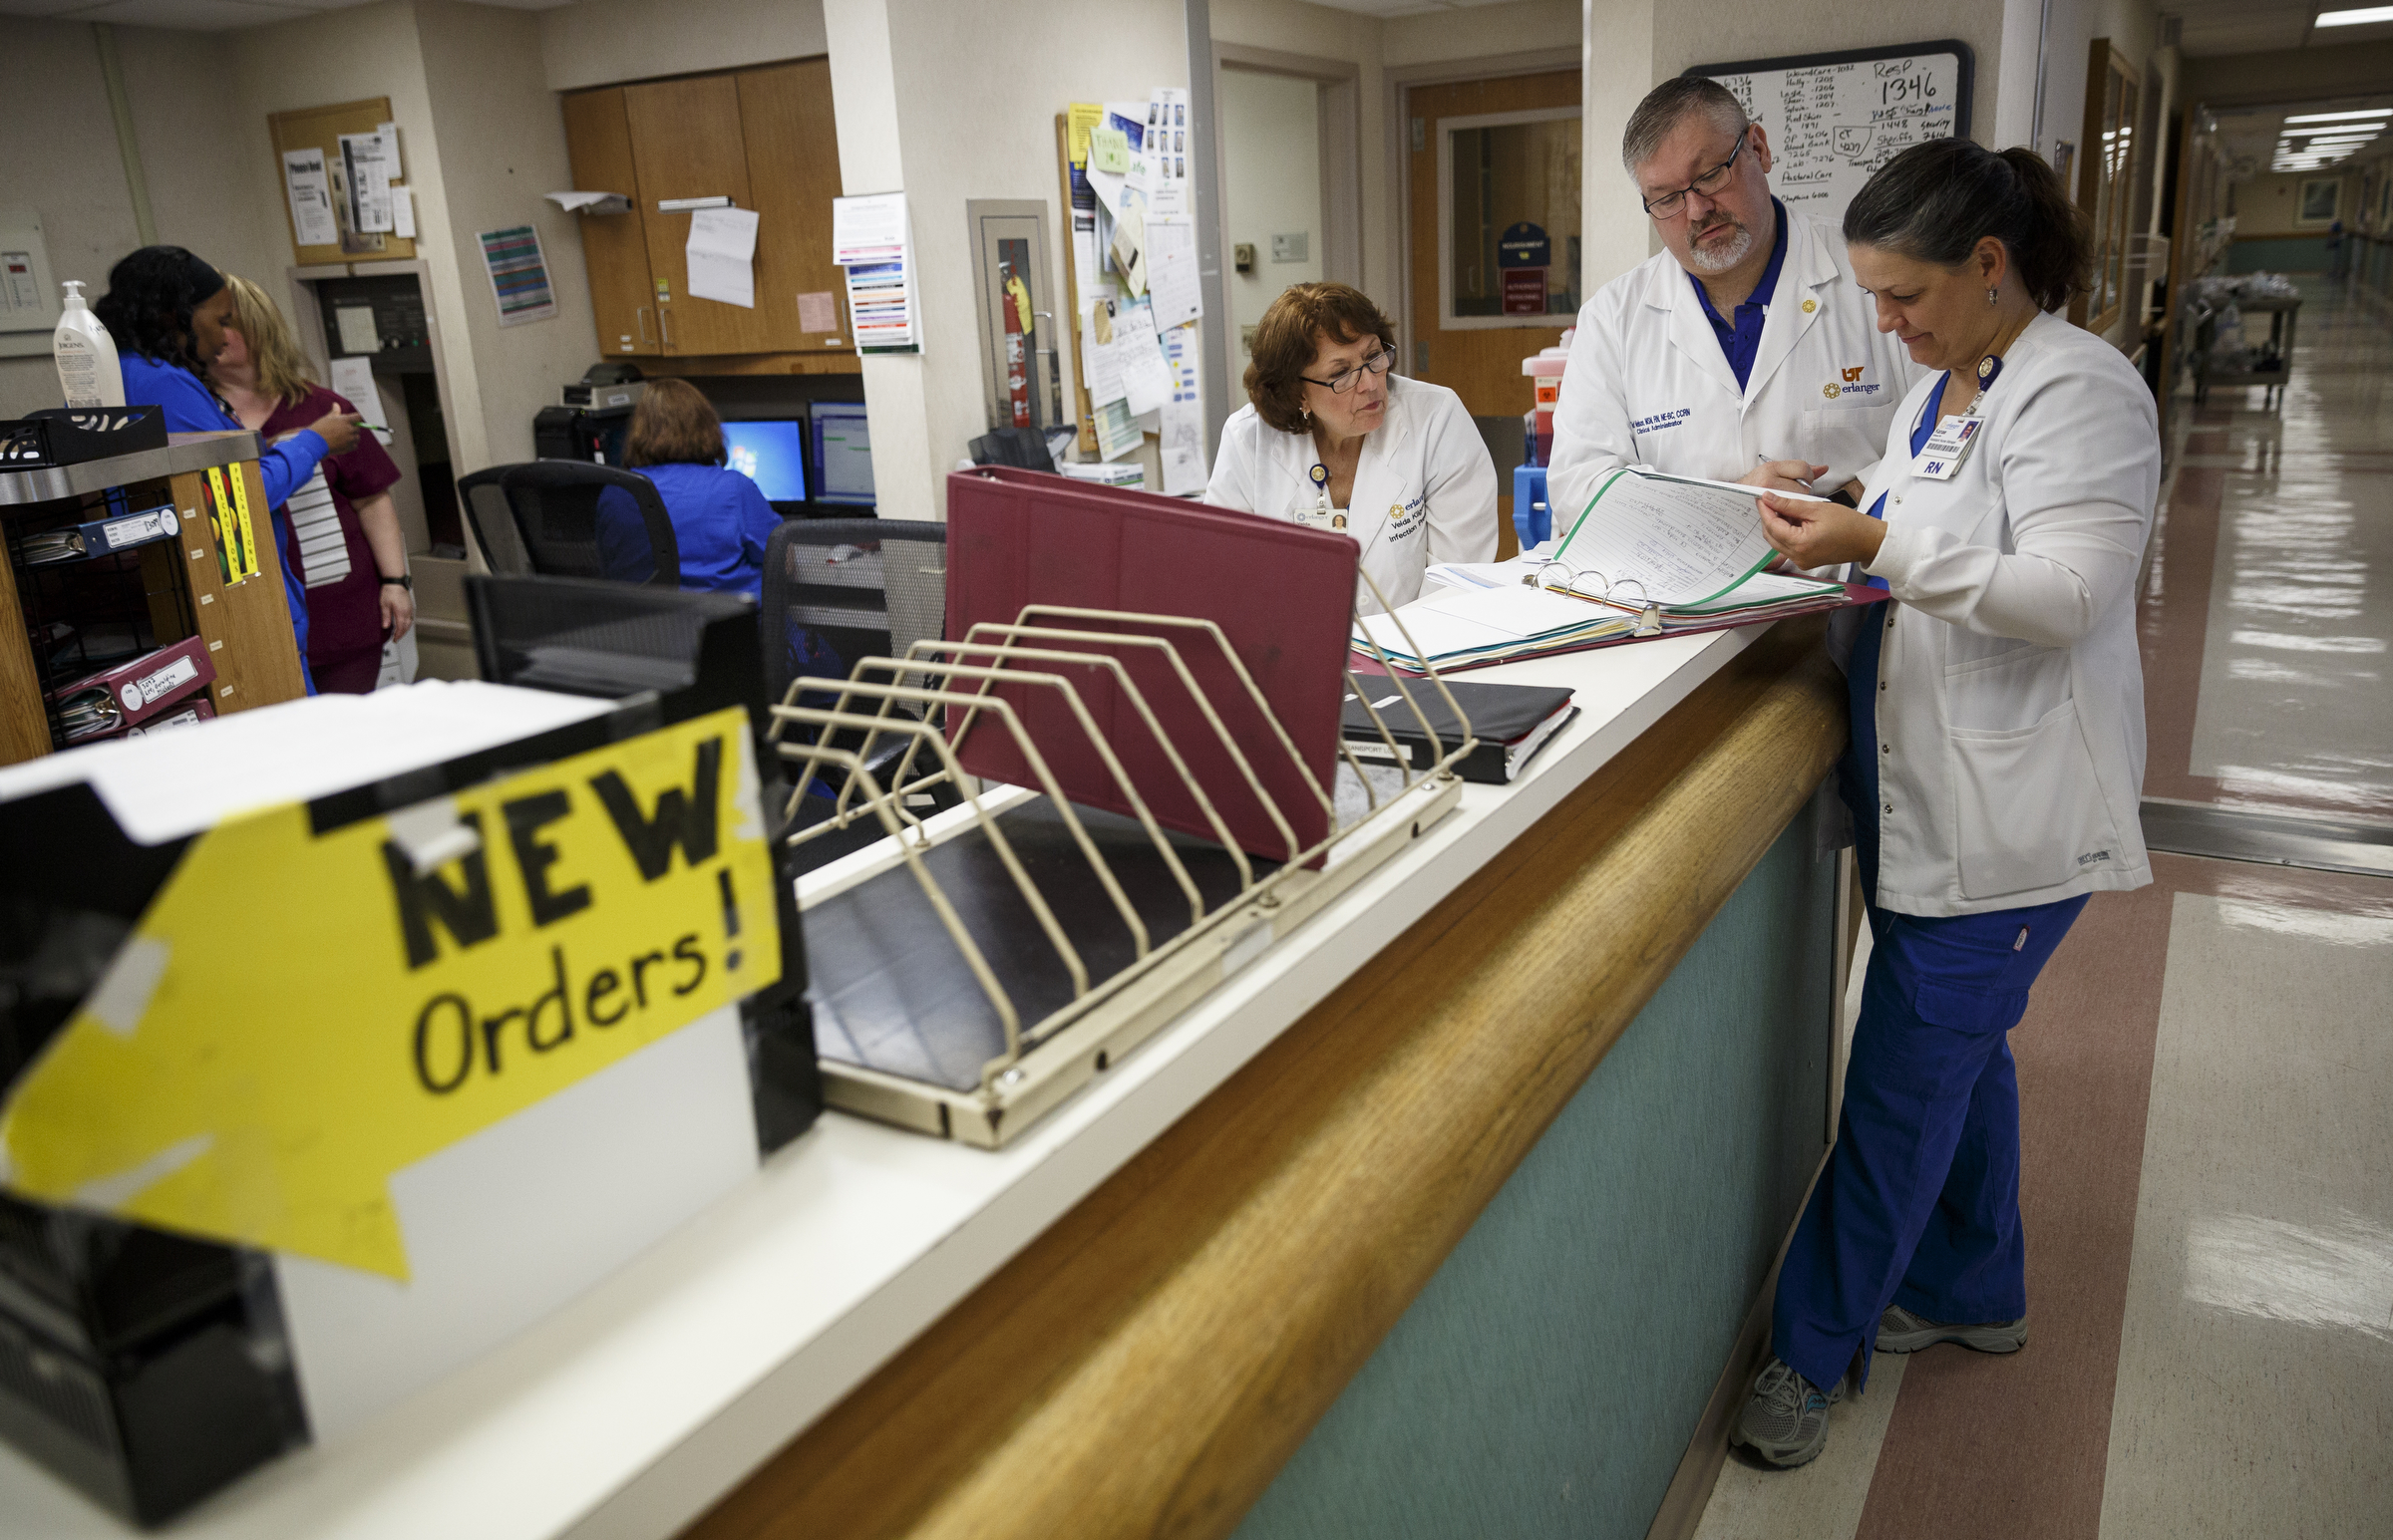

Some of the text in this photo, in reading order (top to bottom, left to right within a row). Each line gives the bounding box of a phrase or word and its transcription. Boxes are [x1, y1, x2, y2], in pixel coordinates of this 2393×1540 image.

[1882, 72, 1936, 105] 1346
[1842, 383, 1880, 395] erlanger
[1923, 461, 1944, 474] RN
[213, 474, 239, 572] PRECAUTIONS
[233, 466, 255, 564] PRECAUTIONS
[1391, 517, 1412, 529] Velda
[1388, 524, 1418, 542] Infection
[378, 733, 725, 975] NEW
